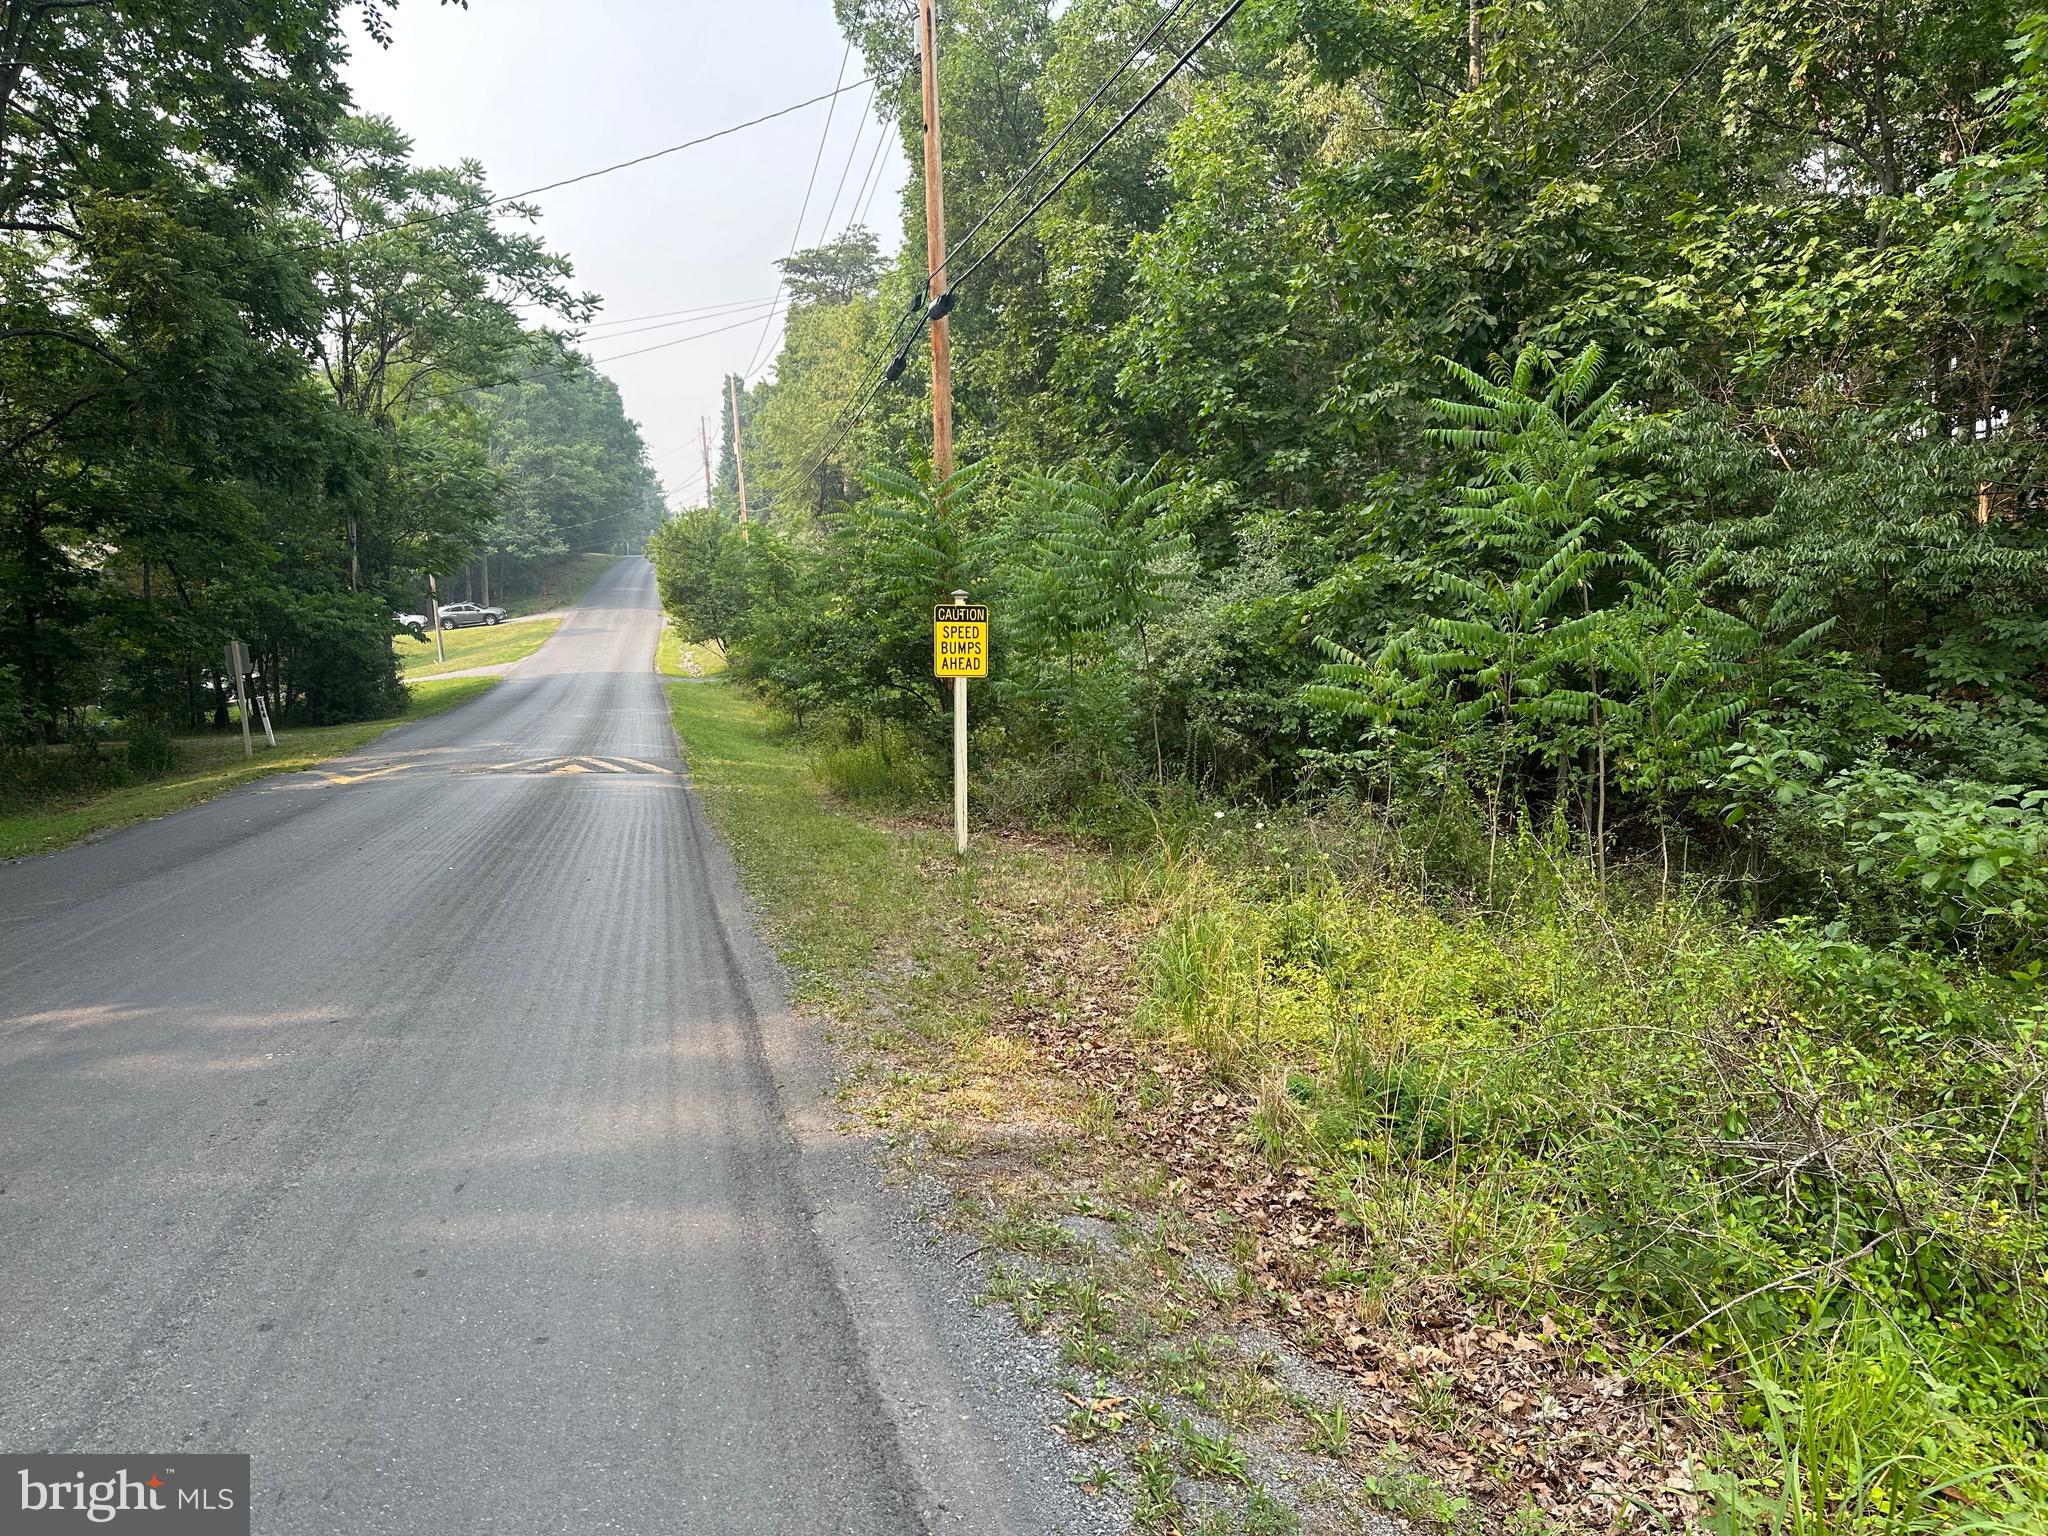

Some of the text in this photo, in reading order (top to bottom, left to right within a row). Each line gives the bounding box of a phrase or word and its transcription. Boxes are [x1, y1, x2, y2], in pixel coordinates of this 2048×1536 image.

[938, 608, 984, 620] CAUTION
[943, 626, 979, 638] SPEED
[941, 641, 981, 654] BUMPS
[941, 657, 981, 670] AHEAD
